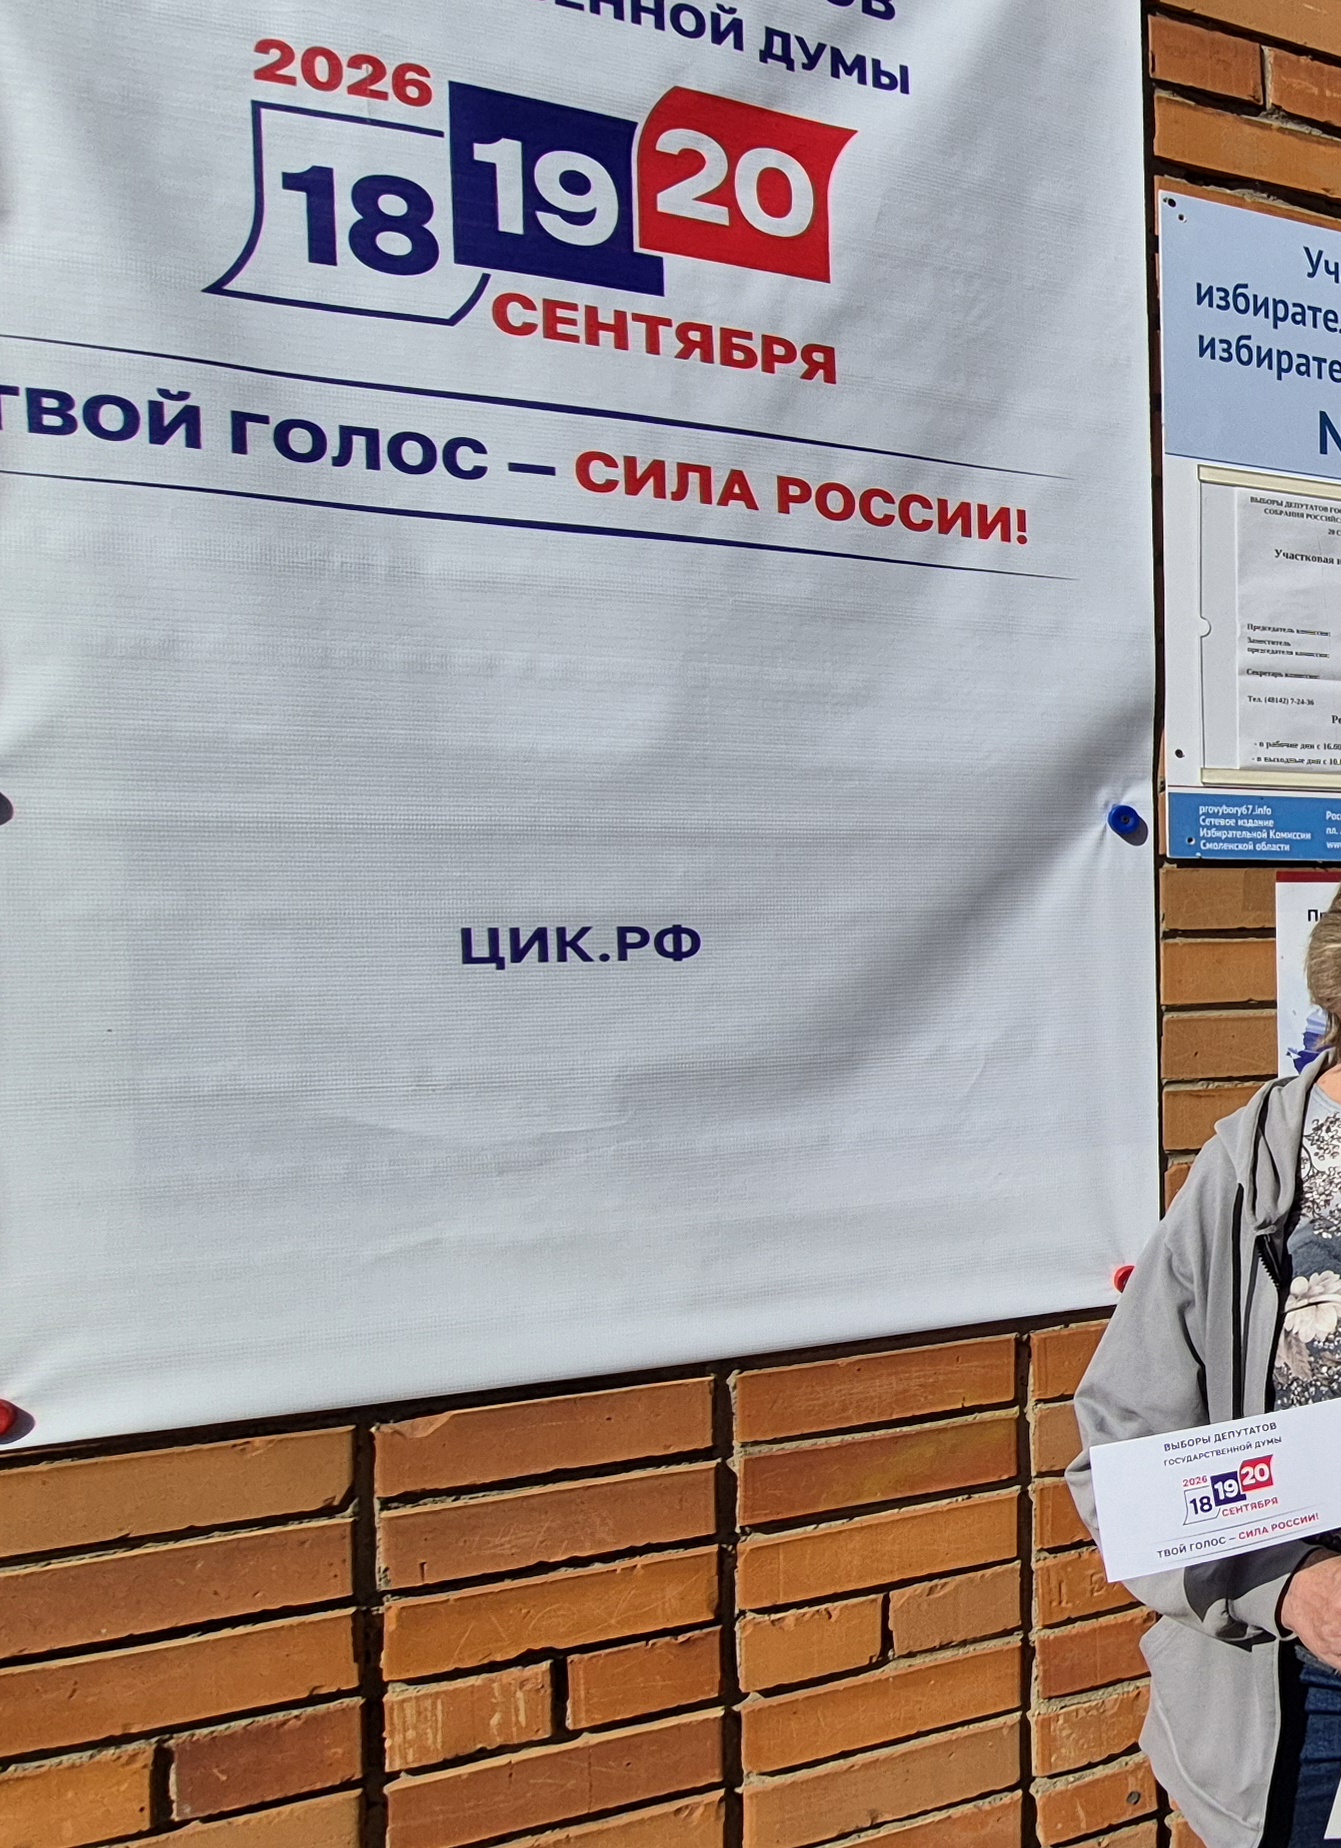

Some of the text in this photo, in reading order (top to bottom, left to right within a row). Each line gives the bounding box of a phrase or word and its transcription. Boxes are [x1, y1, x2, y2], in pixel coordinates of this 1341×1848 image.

[253, 38, 433, 107] 2026
[759, 26, 910, 95] ДУМЫ
[281, 128, 814, 276] 18 19 20
[492, 293, 837, 385] СЕНТЯБРЯ
[230, 410, 488, 481] ГОЛОС
[575, 451, 759, 512] СИЛА
[776, 475, 1028, 545] РОССИИ!
[1284, 501, 1328, 512] ДЕПУТАТОВ
[1275, 549, 1334, 565] Участковая
[1199, 805, 1272, 817] provybory67.info
[1199, 816, 1274, 828] Сетевое издание
[1199, 828, 1311, 840] Избирательной Комиссии
[1200, 840, 1290, 852] Смоленской области
[461, 924, 701, 971] ЦИК.РФ
[1163, 1422, 1277, 1452] ВЫБОРЫ ДЕПУТАТОВ
[1163, 1436, 1282, 1467] ГОСУДАРСТВЕННОЙ ДУМЫ
[1182, 1475, 1208, 1487] 2026
[1189, 1462, 1270, 1515] 18 19 20
[1222, 1497, 1278, 1517] СЕНТЯБРЯ
[1157, 1543, 1187, 1558] ТВОЙ
[1189, 1536, 1227, 1551] ГОЛОС
[1238, 1526, 1269, 1540] СИЛА
[1271, 1512, 1319, 1532] РОССИИ!
